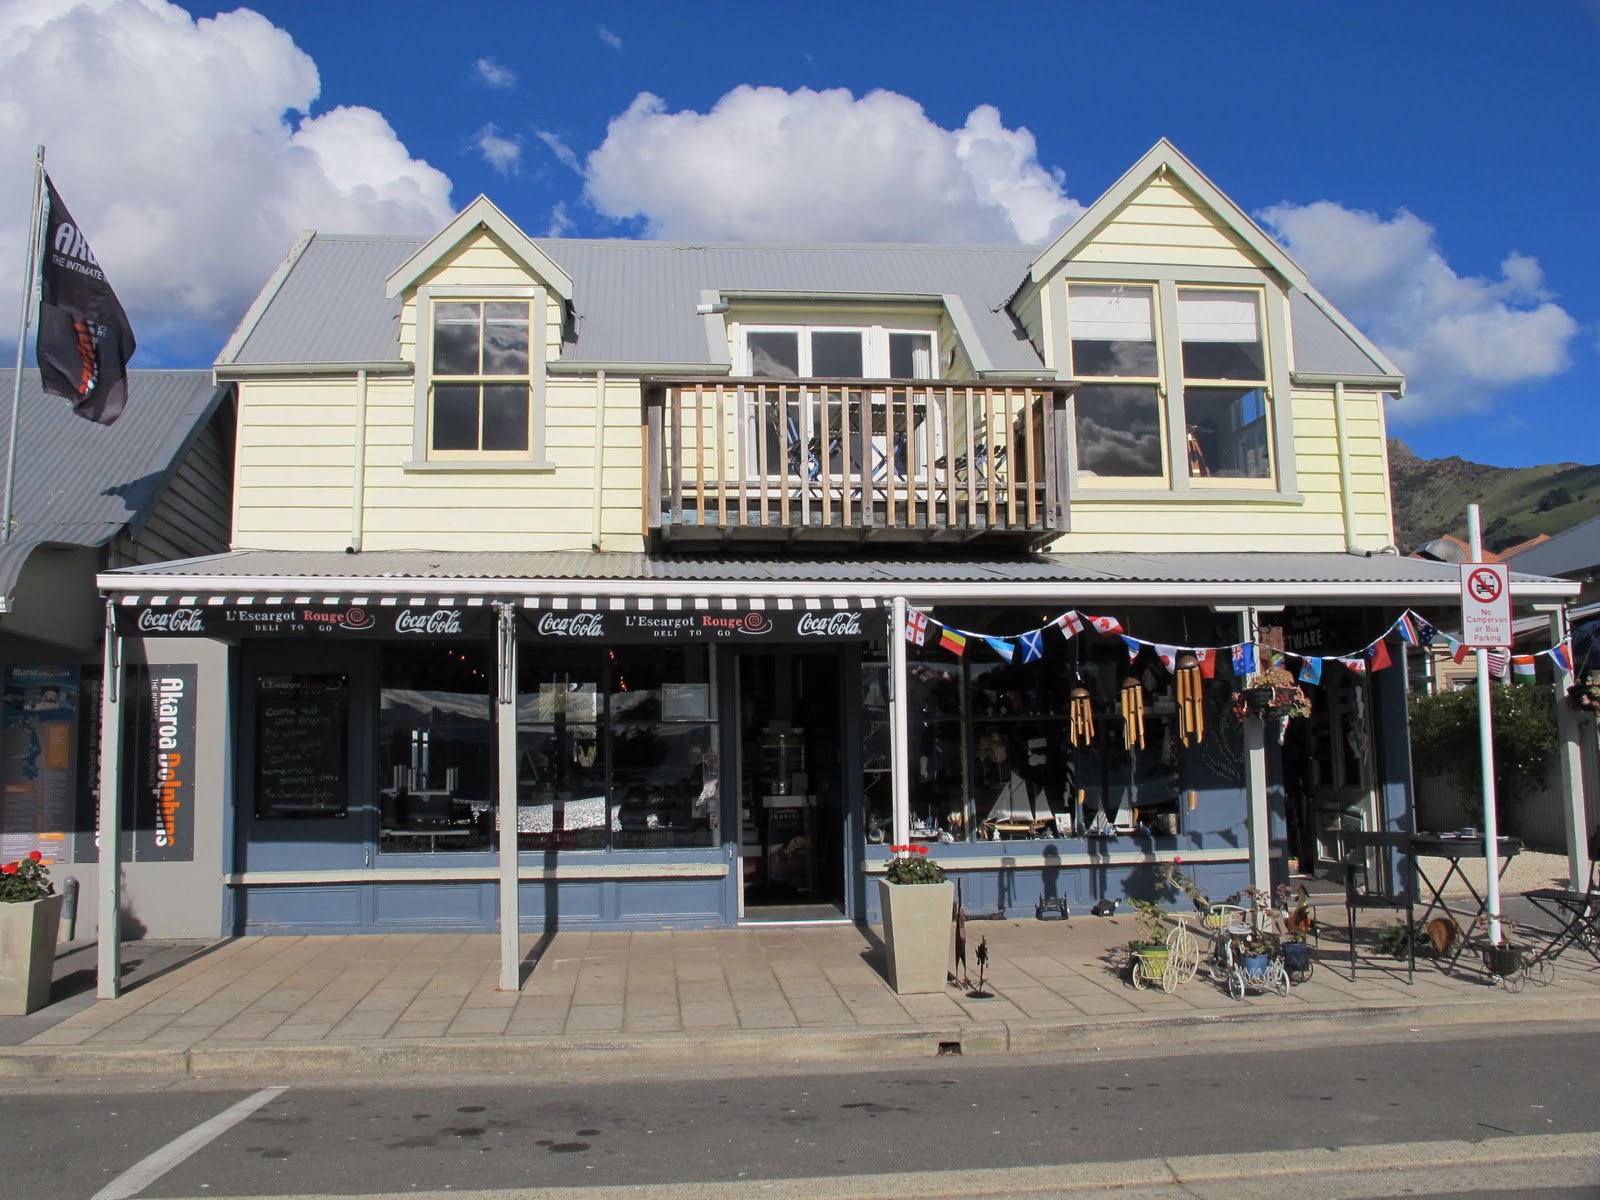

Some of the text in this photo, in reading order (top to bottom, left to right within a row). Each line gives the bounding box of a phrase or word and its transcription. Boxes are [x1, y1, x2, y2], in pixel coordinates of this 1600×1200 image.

[52, 254, 103, 281] THE INTIMATE
[138, 608, 203, 632] Coca-Cola
[225, 610, 345, 624] L'Escargot Rouge
[395, 608, 462, 633] Coca-Cola
[538, 612, 603, 636] Coca-Cola
[625, 615, 743, 628] L'Escargot Rouge
[797, 612, 861, 636] Coca-Cola
[1466, 616, 1507, 624] Campervan
[1284, 628, 1323, 650] TWARE
[151, 679, 159, 691] THE
[90, 692, 98, 721] INTIMATE
[158, 678, 184, 749] Akaroa
[89, 722, 98, 748] NATURE
[148, 722, 157, 748] NATURE
[88, 749, 97, 788] EXPERIENCE
[152, 753, 182, 847] Dolphins
